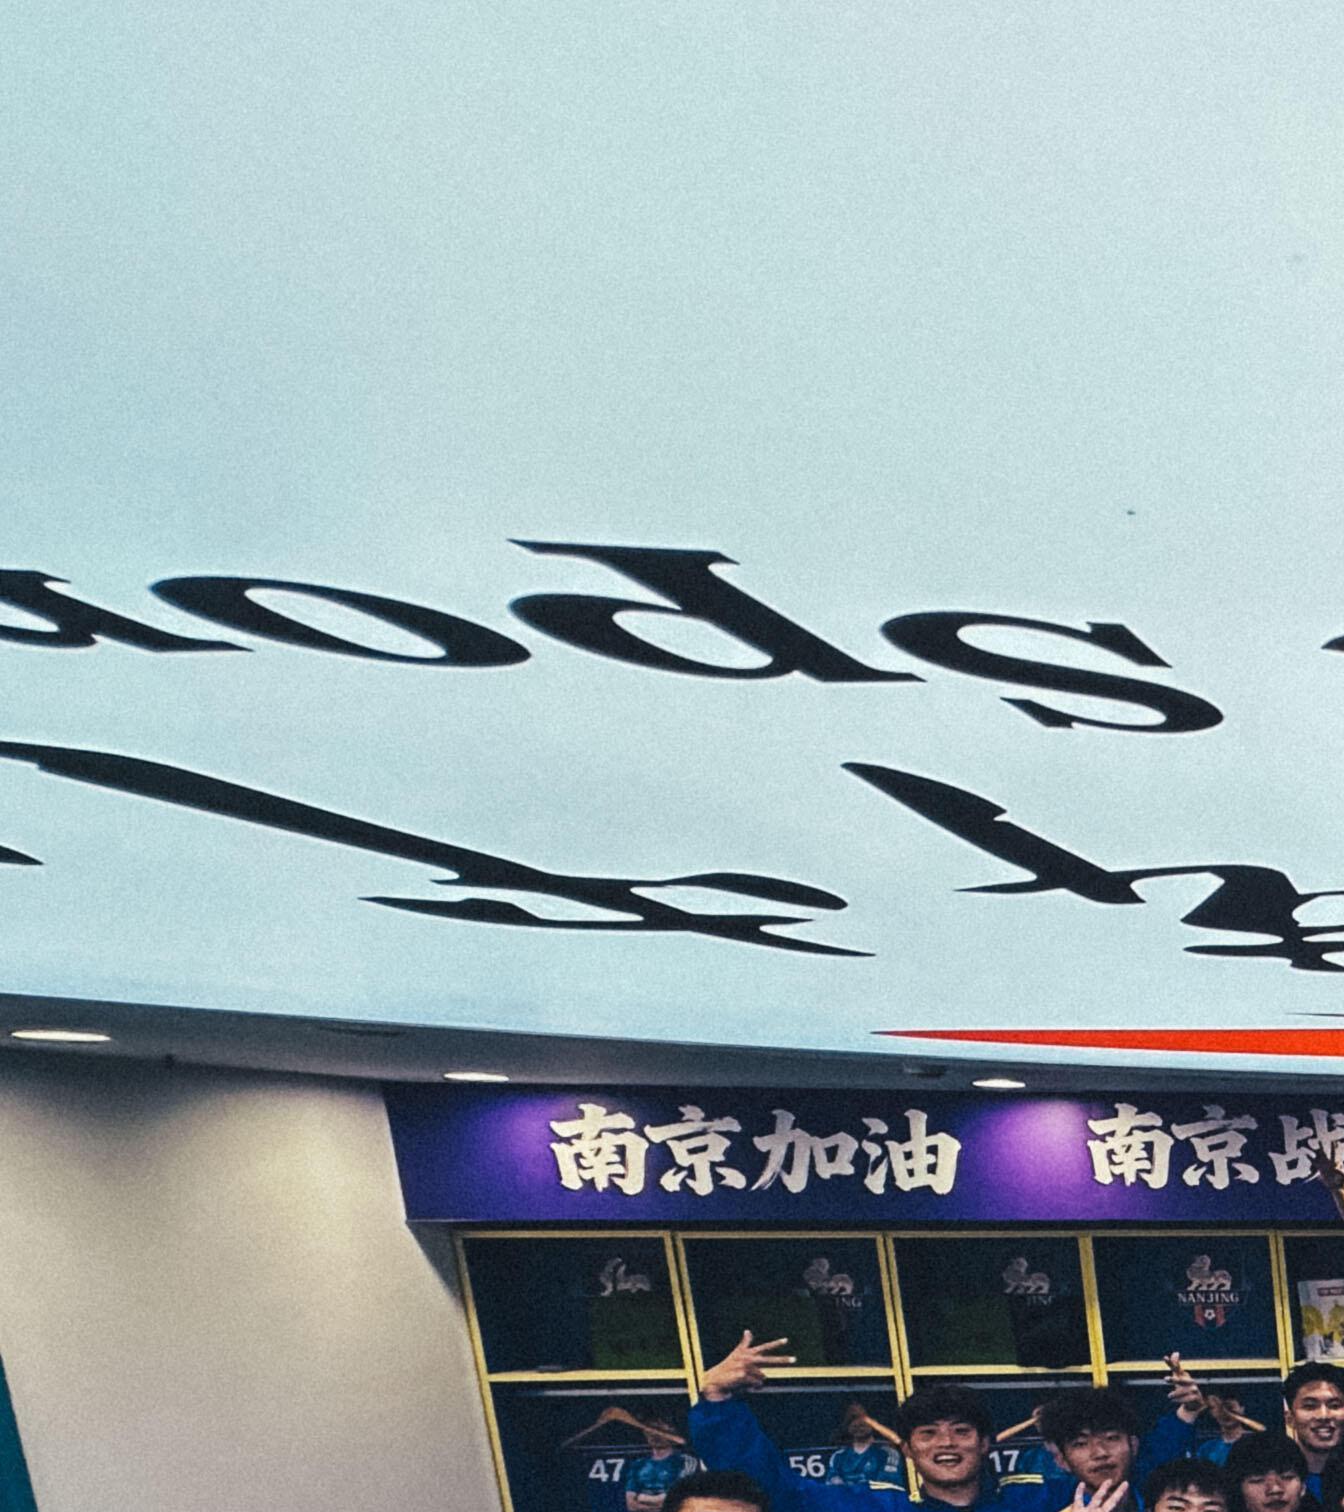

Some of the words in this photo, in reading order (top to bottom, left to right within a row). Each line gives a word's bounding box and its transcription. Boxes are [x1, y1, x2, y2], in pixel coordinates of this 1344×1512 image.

[549, 1103, 961, 1197] 南京加油
[1178, 1292, 1239, 1303] NANJING
[588, 1458, 625, 1482] 47
[789, 1454, 825, 1477] 56
[989, 1450, 1020, 1473] 17
